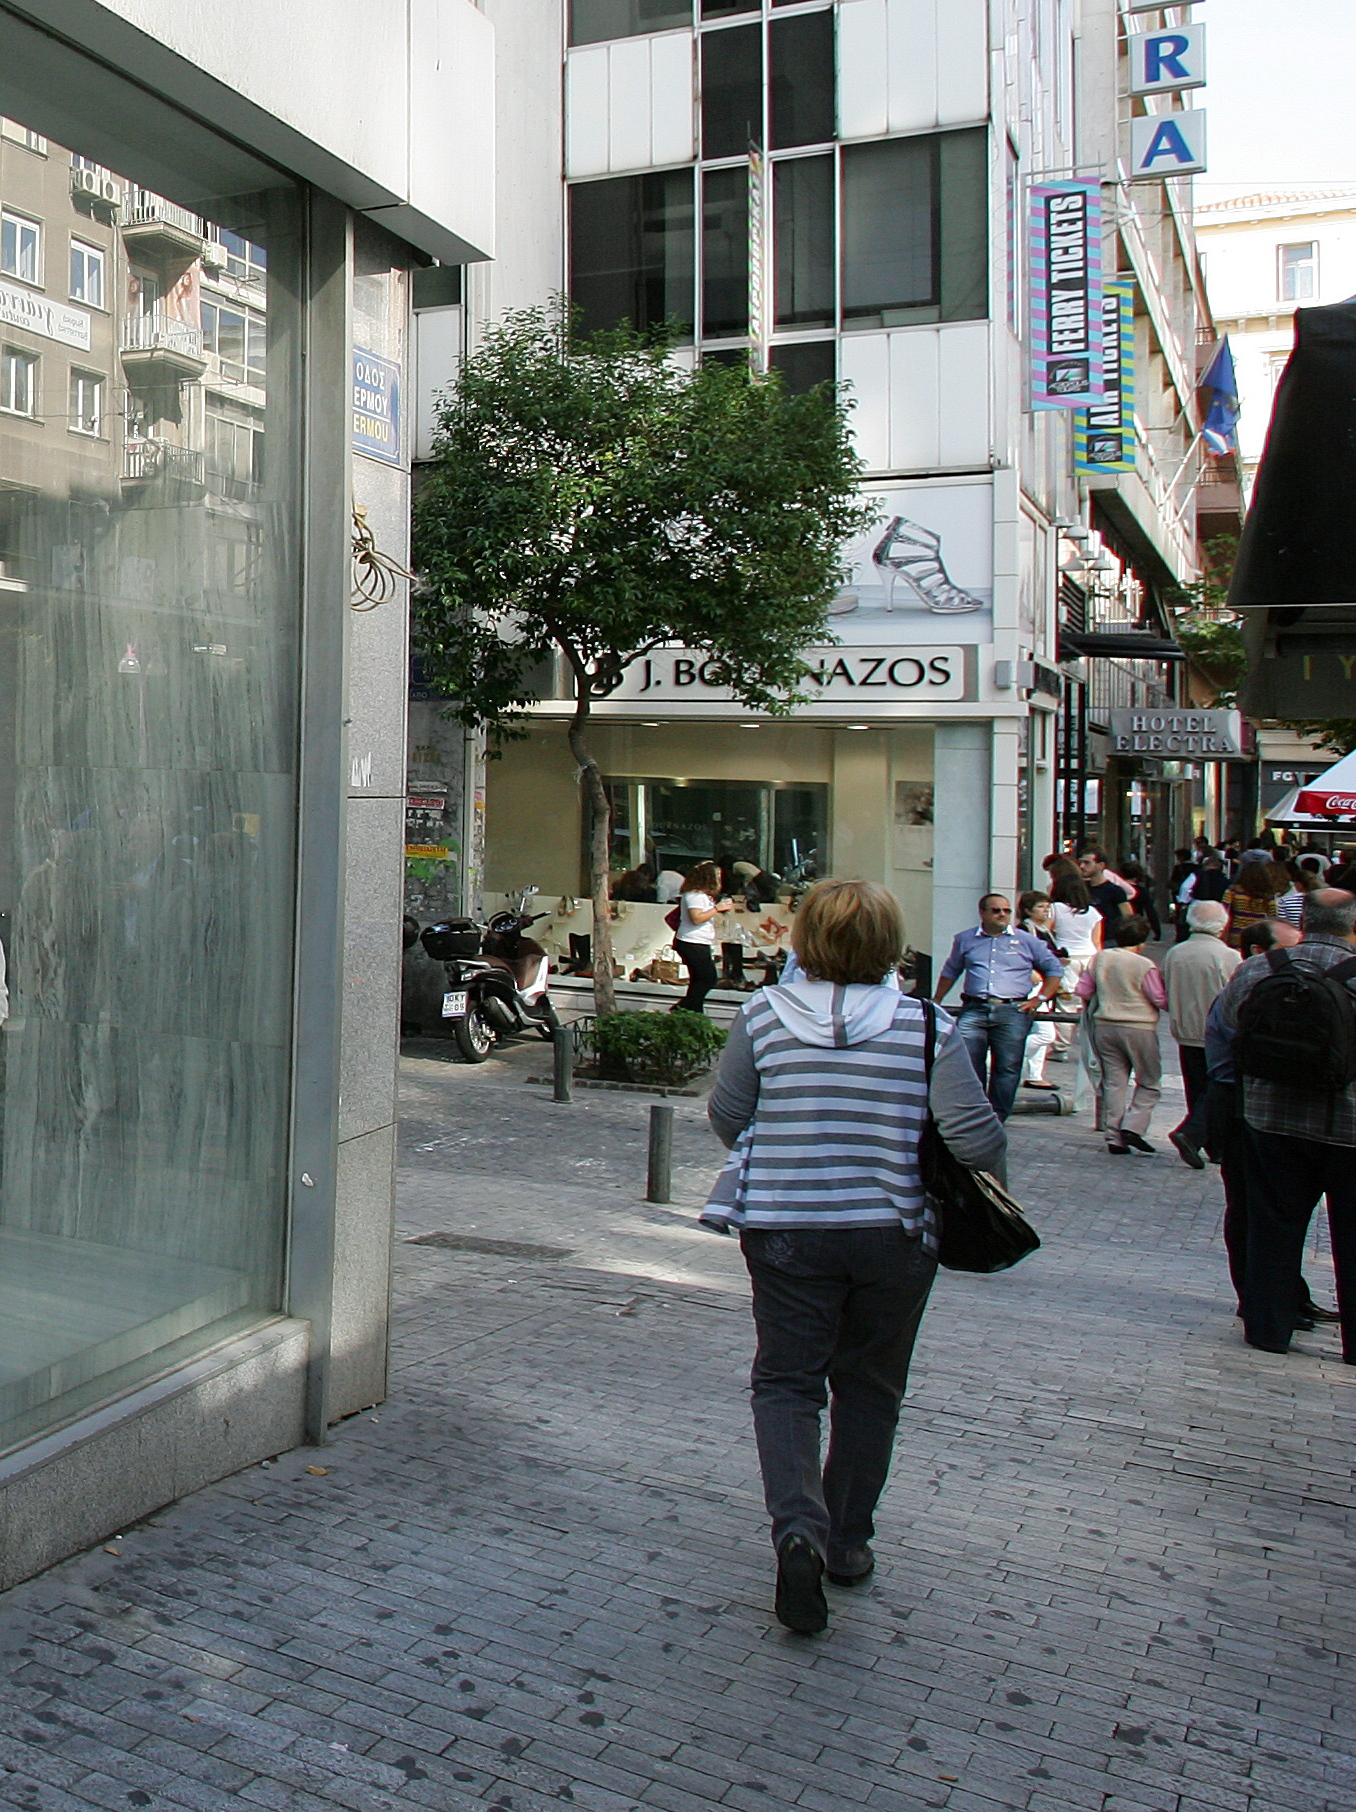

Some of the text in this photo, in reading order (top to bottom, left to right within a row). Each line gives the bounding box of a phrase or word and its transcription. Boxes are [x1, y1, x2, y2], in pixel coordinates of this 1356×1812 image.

[1050, 194, 1084, 282] TICKETS
[1052, 289, 1085, 353] FERRY
[356, 362, 386, 390] ΟΔΟΣ
[354, 386, 388, 416] ΕΡΜΟΥ
[353, 413, 389, 442] ERMOU
[640, 659, 662, 693] J.
[1132, 715, 1218, 733] HOTEL
[1115, 735, 1234, 753] ELECTRA
